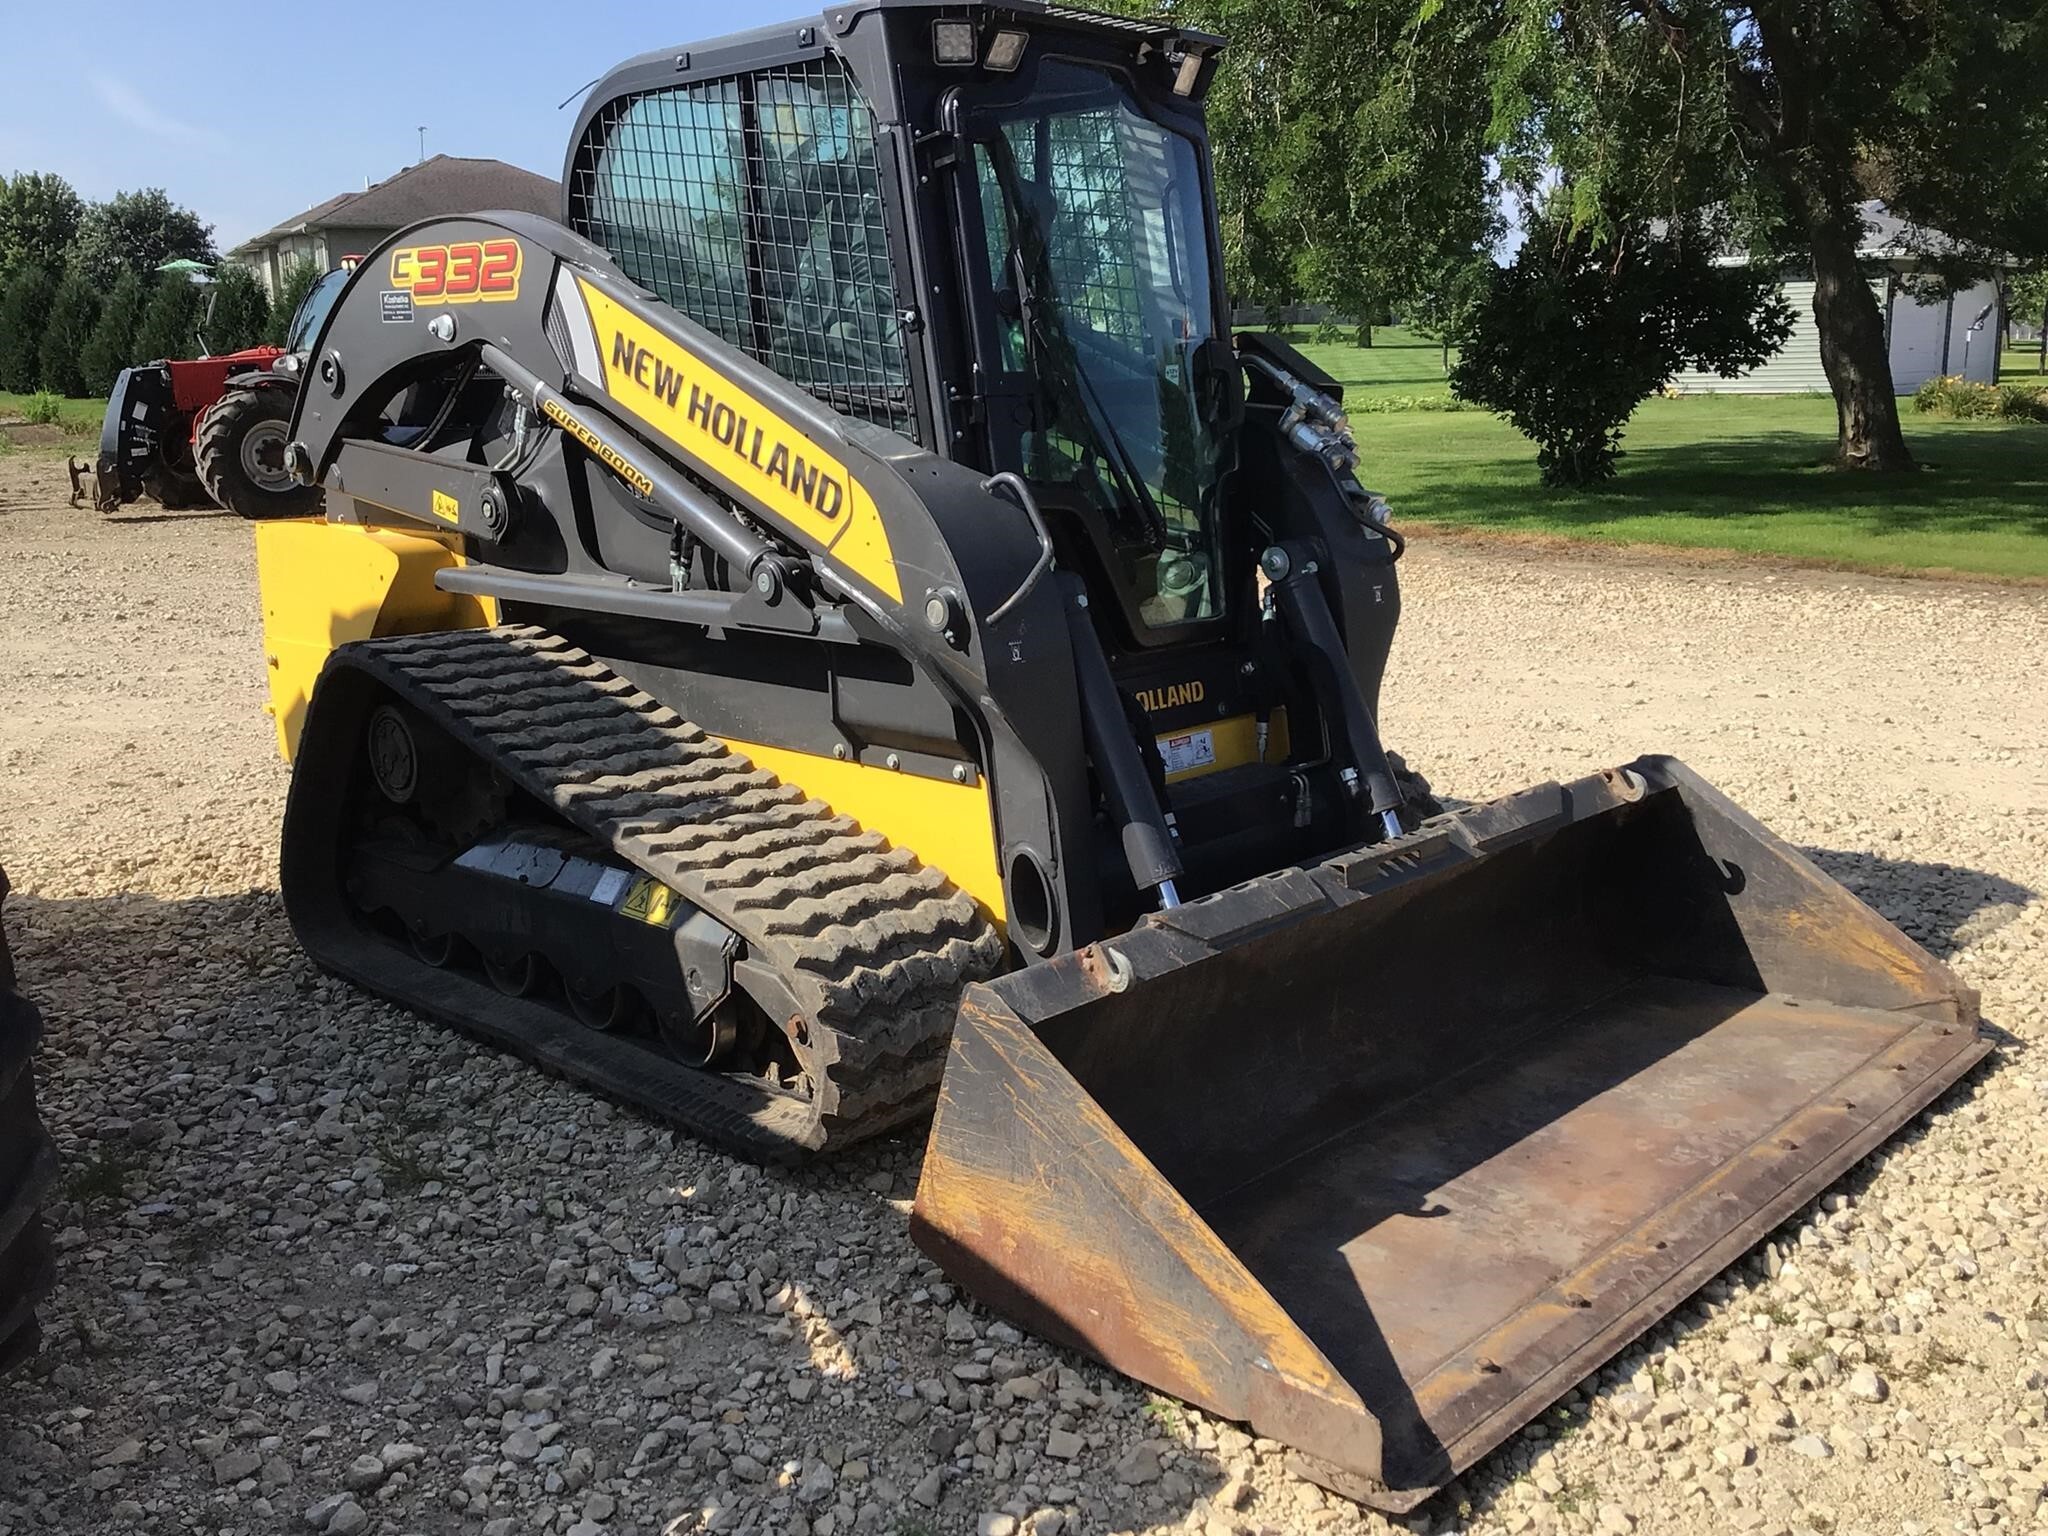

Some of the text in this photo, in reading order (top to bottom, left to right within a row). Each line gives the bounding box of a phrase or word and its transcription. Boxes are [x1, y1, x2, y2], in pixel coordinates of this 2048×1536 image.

[391, 240, 521, 302] C332
[545, 400, 653, 494] SUPER BOOM
[612, 330, 843, 520] NEW HOLLAND
[1135, 681, 1204, 712] OLLAND
